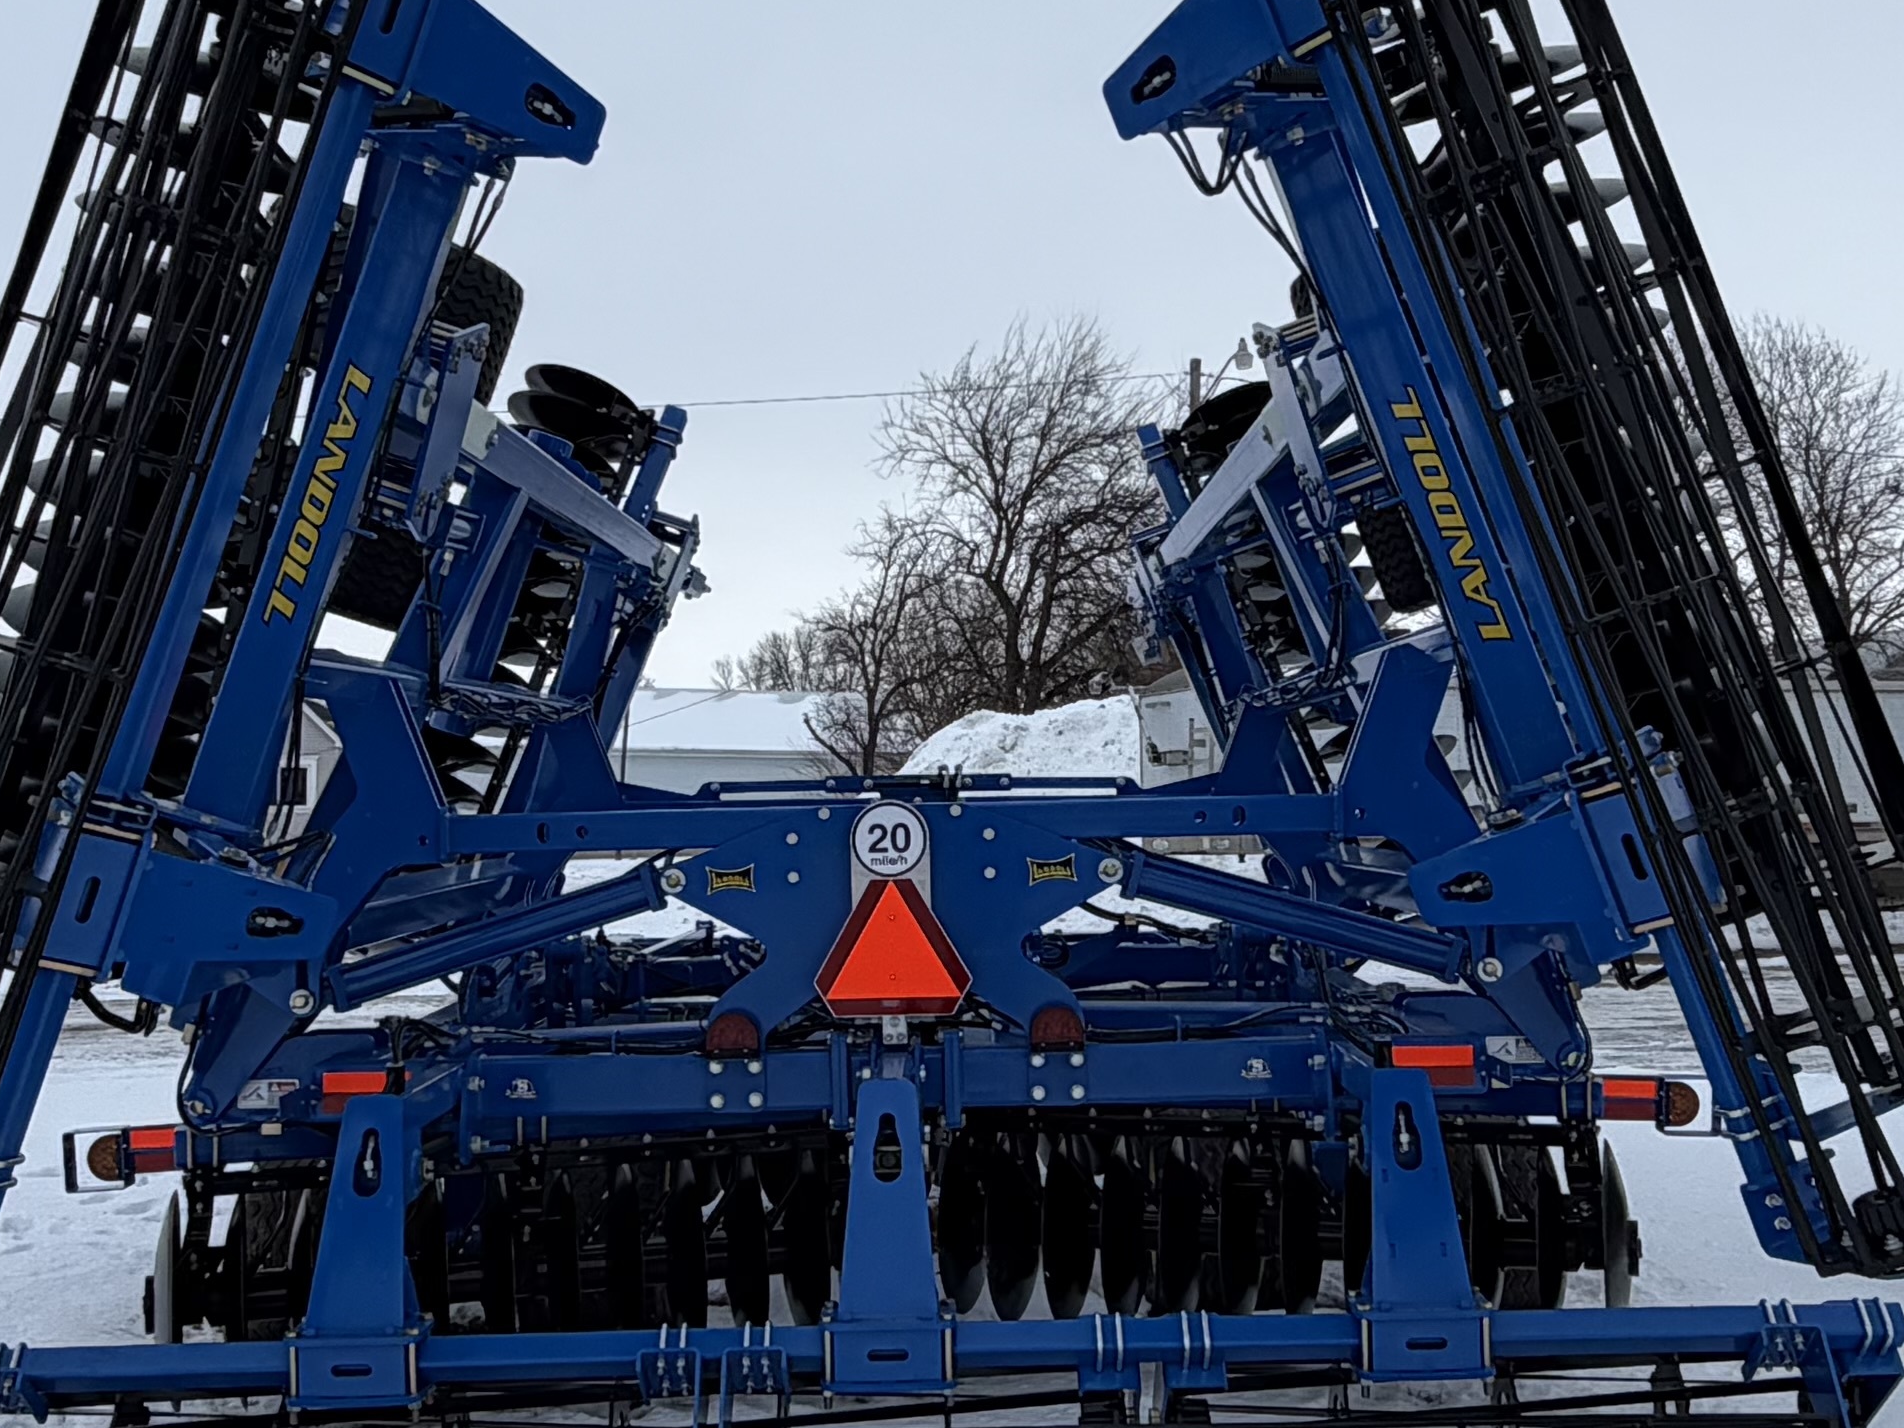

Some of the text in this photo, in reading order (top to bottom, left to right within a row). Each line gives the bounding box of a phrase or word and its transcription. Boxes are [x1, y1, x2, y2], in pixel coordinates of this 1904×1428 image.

[264, 364, 371, 624] LANDOLL
[1391, 386, 1512, 641] LANDOLL
[868, 822, 911, 853] 20
